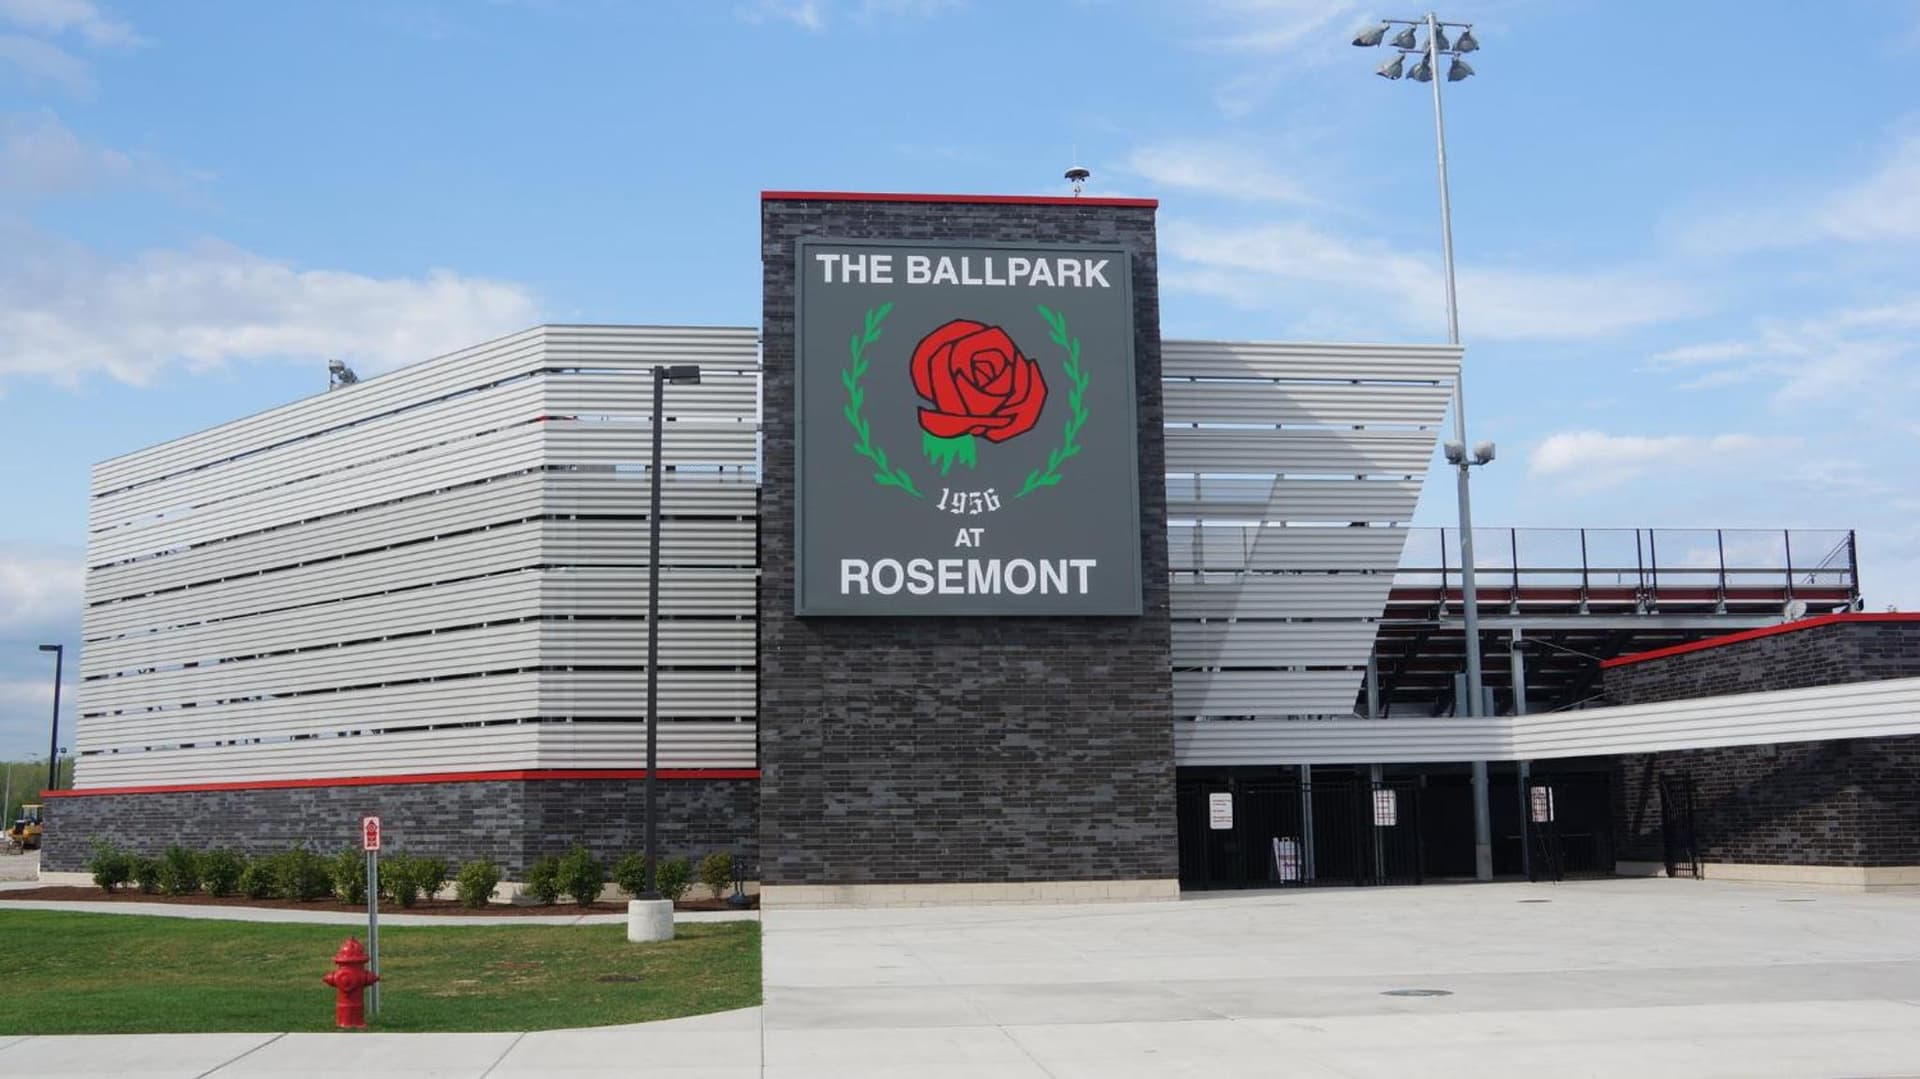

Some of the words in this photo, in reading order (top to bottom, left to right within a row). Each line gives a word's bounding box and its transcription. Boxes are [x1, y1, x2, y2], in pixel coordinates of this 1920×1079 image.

[815, 253, 894, 284] THE
[906, 255, 1111, 288] BALLPARK
[936, 487, 1001, 514] 1956
[954, 528, 985, 547] AT
[841, 558, 1097, 596] ROSEMONT
